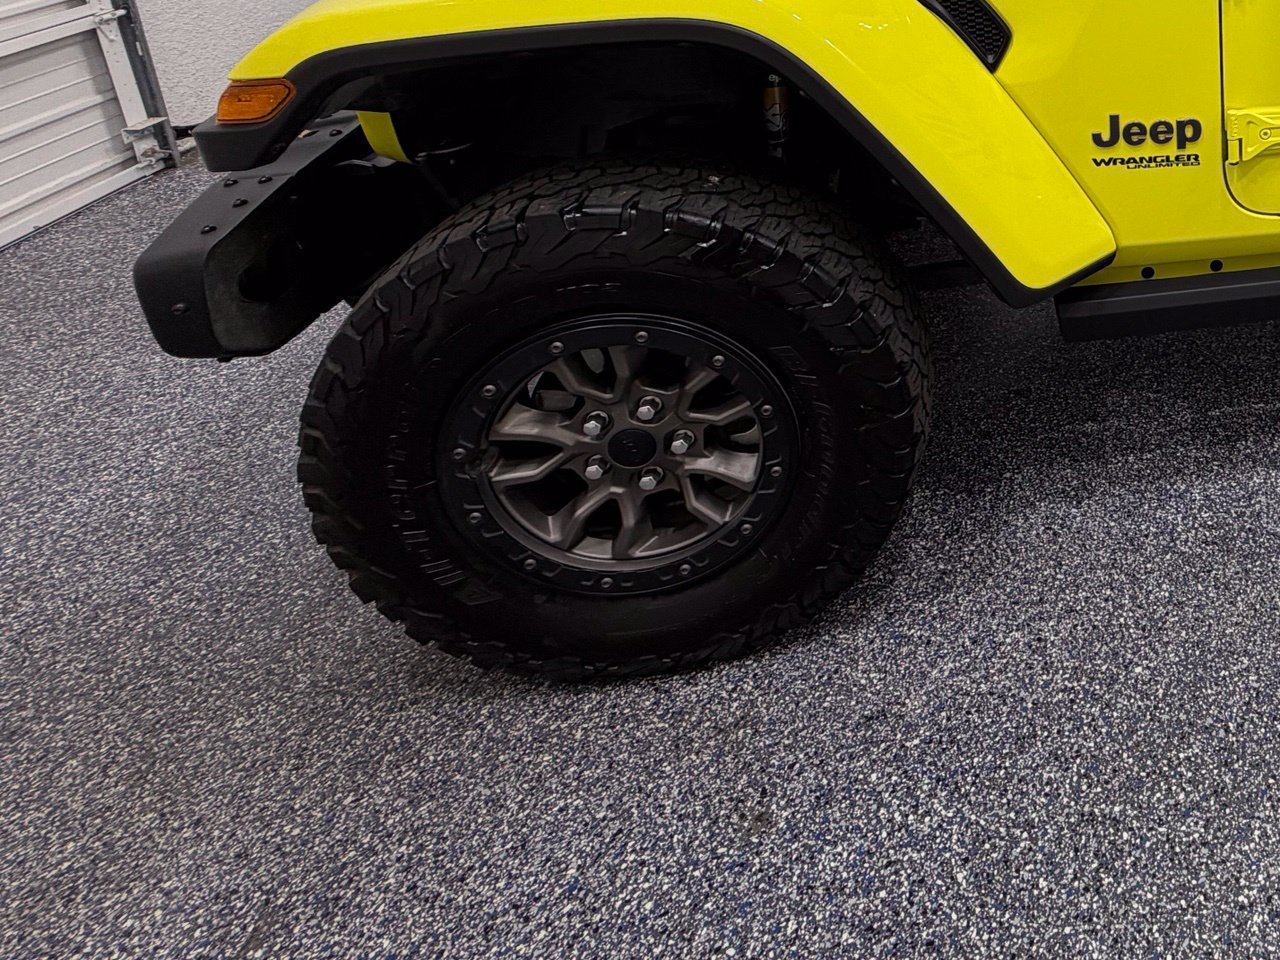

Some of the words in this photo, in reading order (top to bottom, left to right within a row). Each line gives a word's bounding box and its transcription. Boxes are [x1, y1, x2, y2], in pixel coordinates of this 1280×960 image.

[1091, 113, 1203, 150] Jeep
[1091, 153, 1201, 167] WRANGLER
[1126, 161, 1201, 169] UNLIMITED
